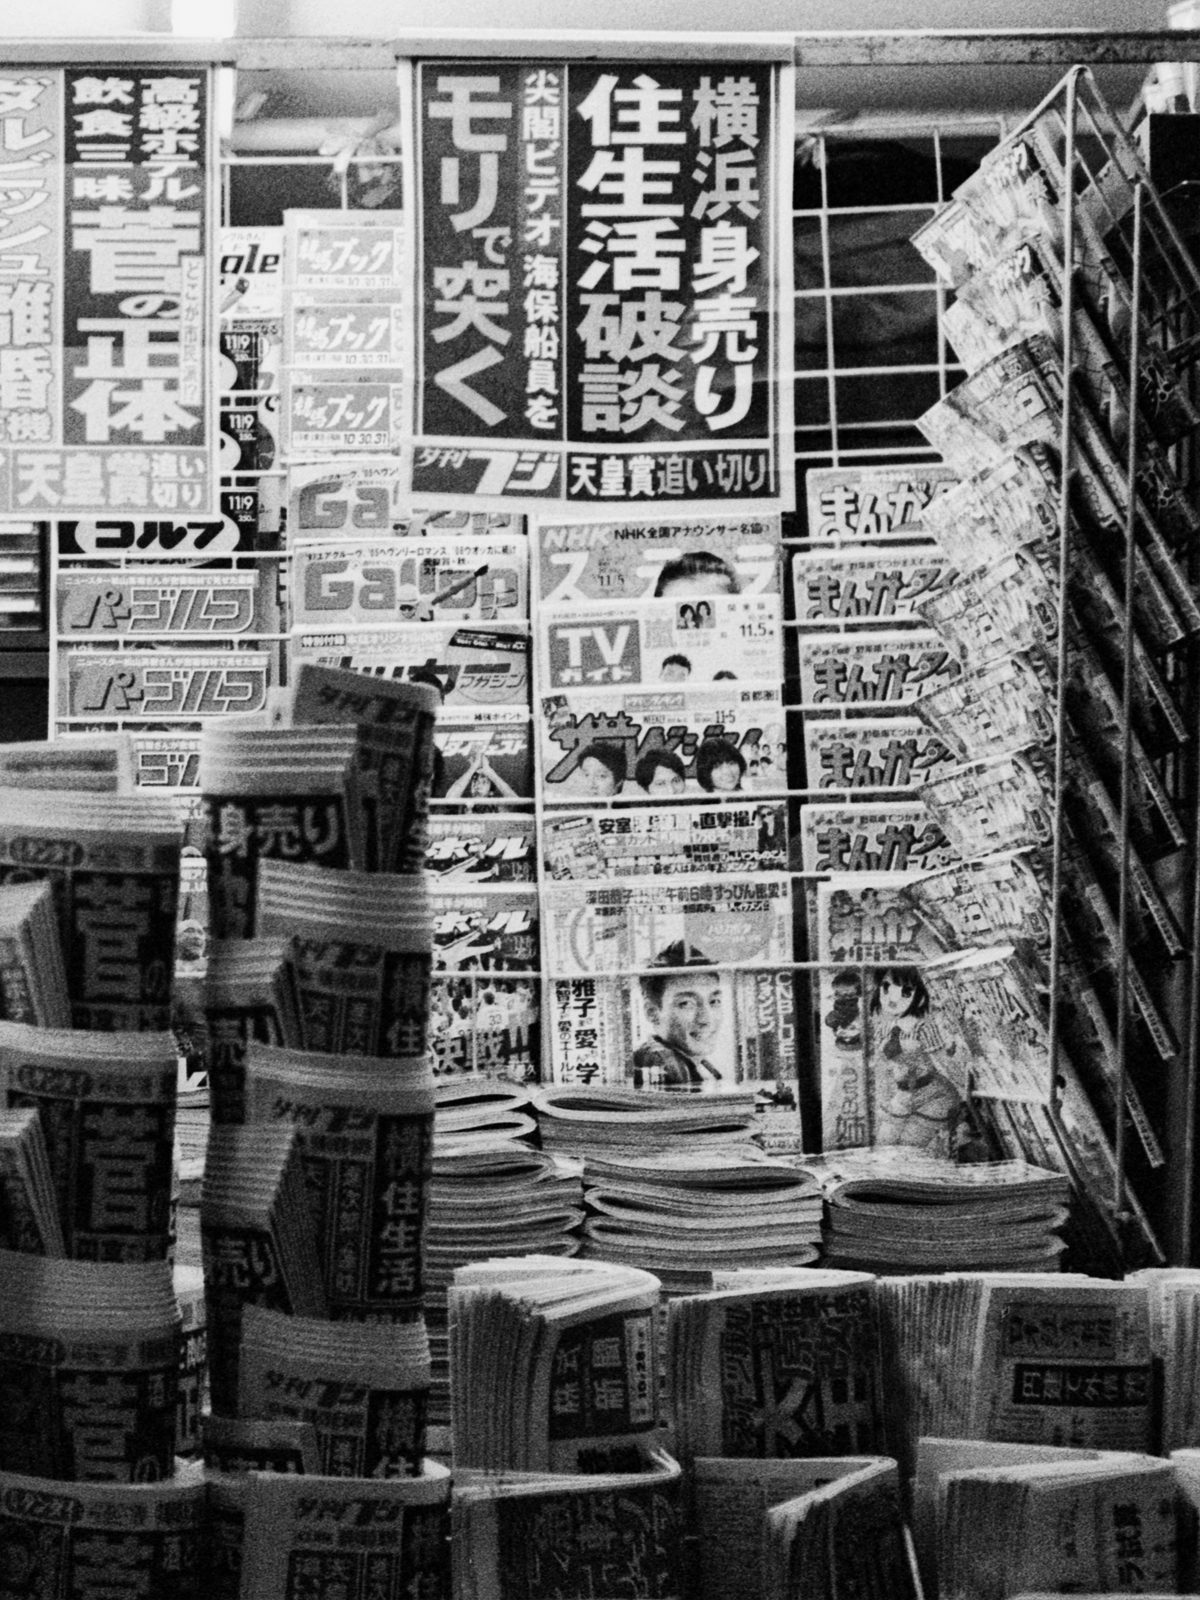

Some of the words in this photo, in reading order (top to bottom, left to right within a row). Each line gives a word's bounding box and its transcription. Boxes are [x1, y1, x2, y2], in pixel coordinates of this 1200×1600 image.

[138, 77, 201, 201] 高級ホテル
[428, 75, 512, 427] モリで突く
[576, 74, 688, 433] 住生活破談
[690, 76, 760, 432] 横浜身売り
[69, 205, 201, 443] 菅の正体
